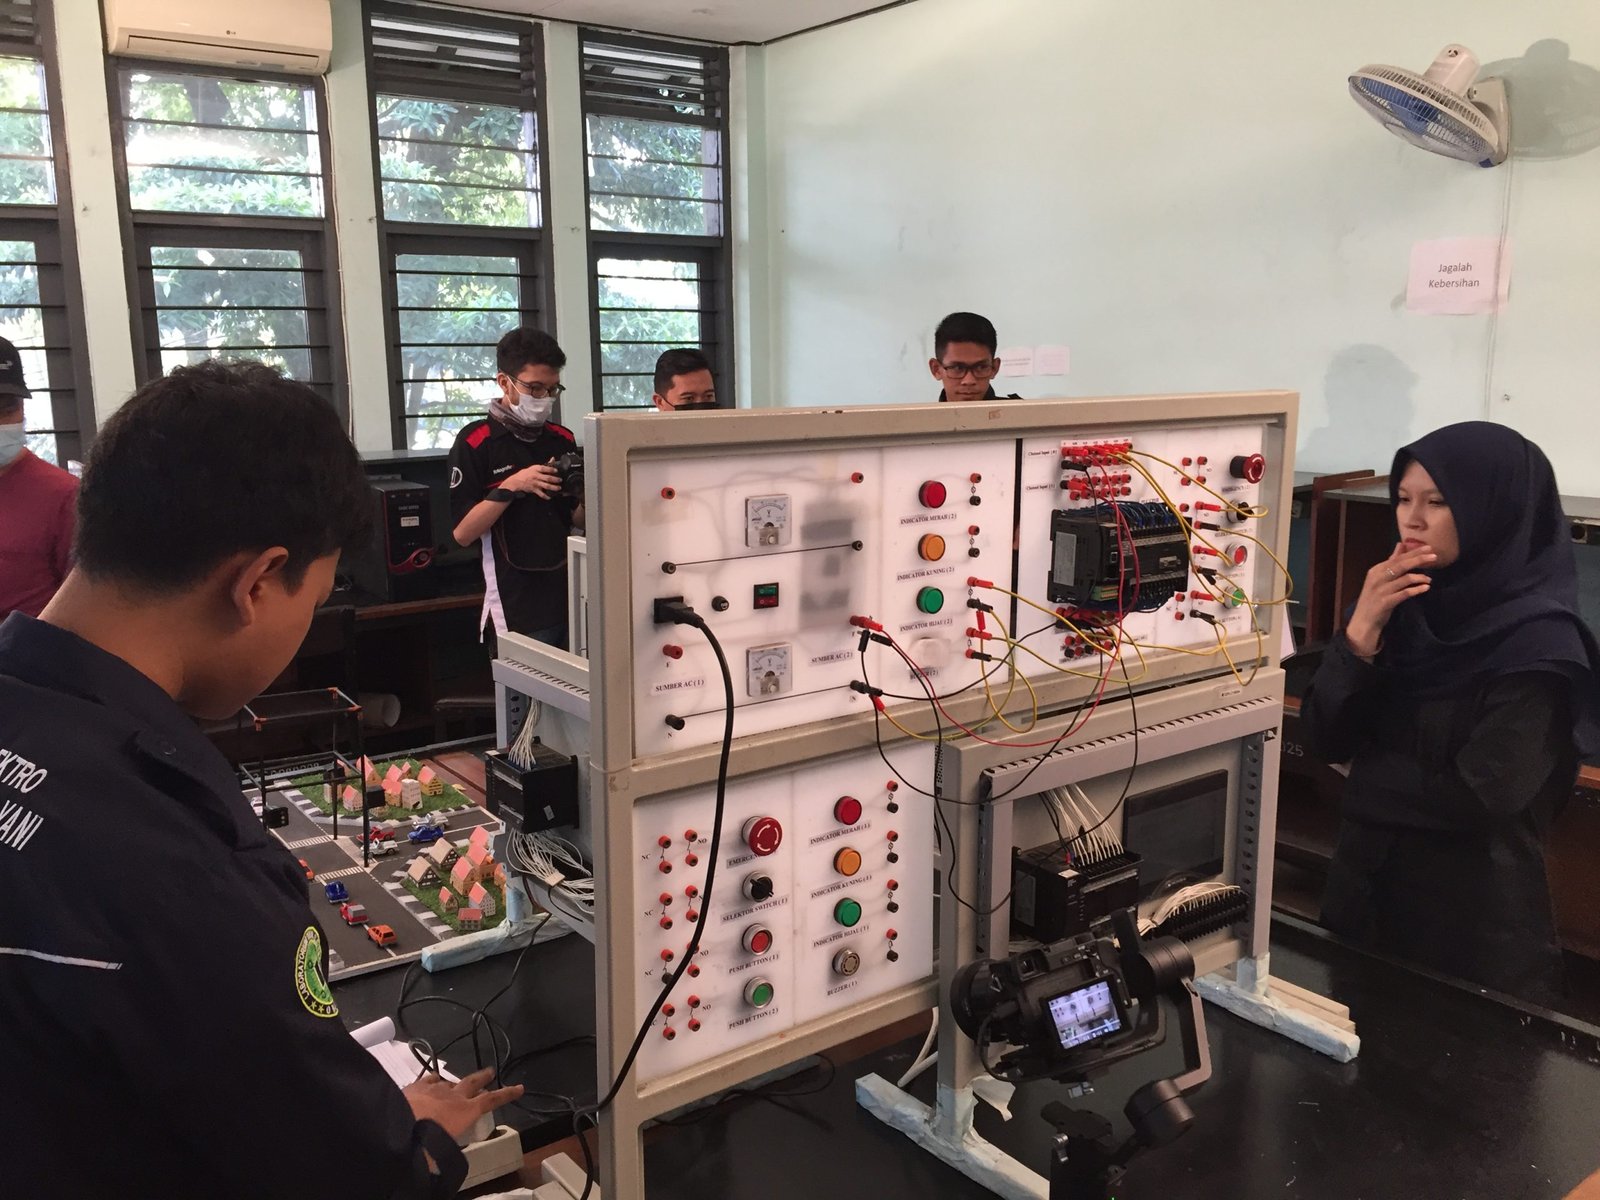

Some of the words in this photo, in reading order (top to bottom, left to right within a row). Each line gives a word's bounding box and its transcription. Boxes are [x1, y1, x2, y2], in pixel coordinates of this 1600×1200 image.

[1438, 262, 1472, 274] Jagalah
[1428, 278, 1480, 288] Kebersihan
[900, 515, 929, 525] INDICATOR
[897, 570, 926, 581] INDICATOR
[926, 567, 946, 576] KUNING
[900, 622, 928, 632] INDICATOR
[811, 654, 835, 663] SUMBER
[655, 681, 683, 692] SUMBER
[1282, 741, 1304, 757] 25
[810, 831, 841, 845] INDICATOR
[811, 884, 842, 898] INDICATOR
[842, 877, 863, 888] KUNING
[722, 908, 754, 921] SELEKTOR
[754, 900, 778, 911] SWITCH
[813, 933, 843, 947] INDICATOR
[728, 964, 745, 974] PUSH
[745, 956, 769, 969] BUTTON
[827, 983, 848, 996] BUZZER
[728, 1019, 745, 1030] PUSH
[745, 1010, 769, 1023] BUTTON
